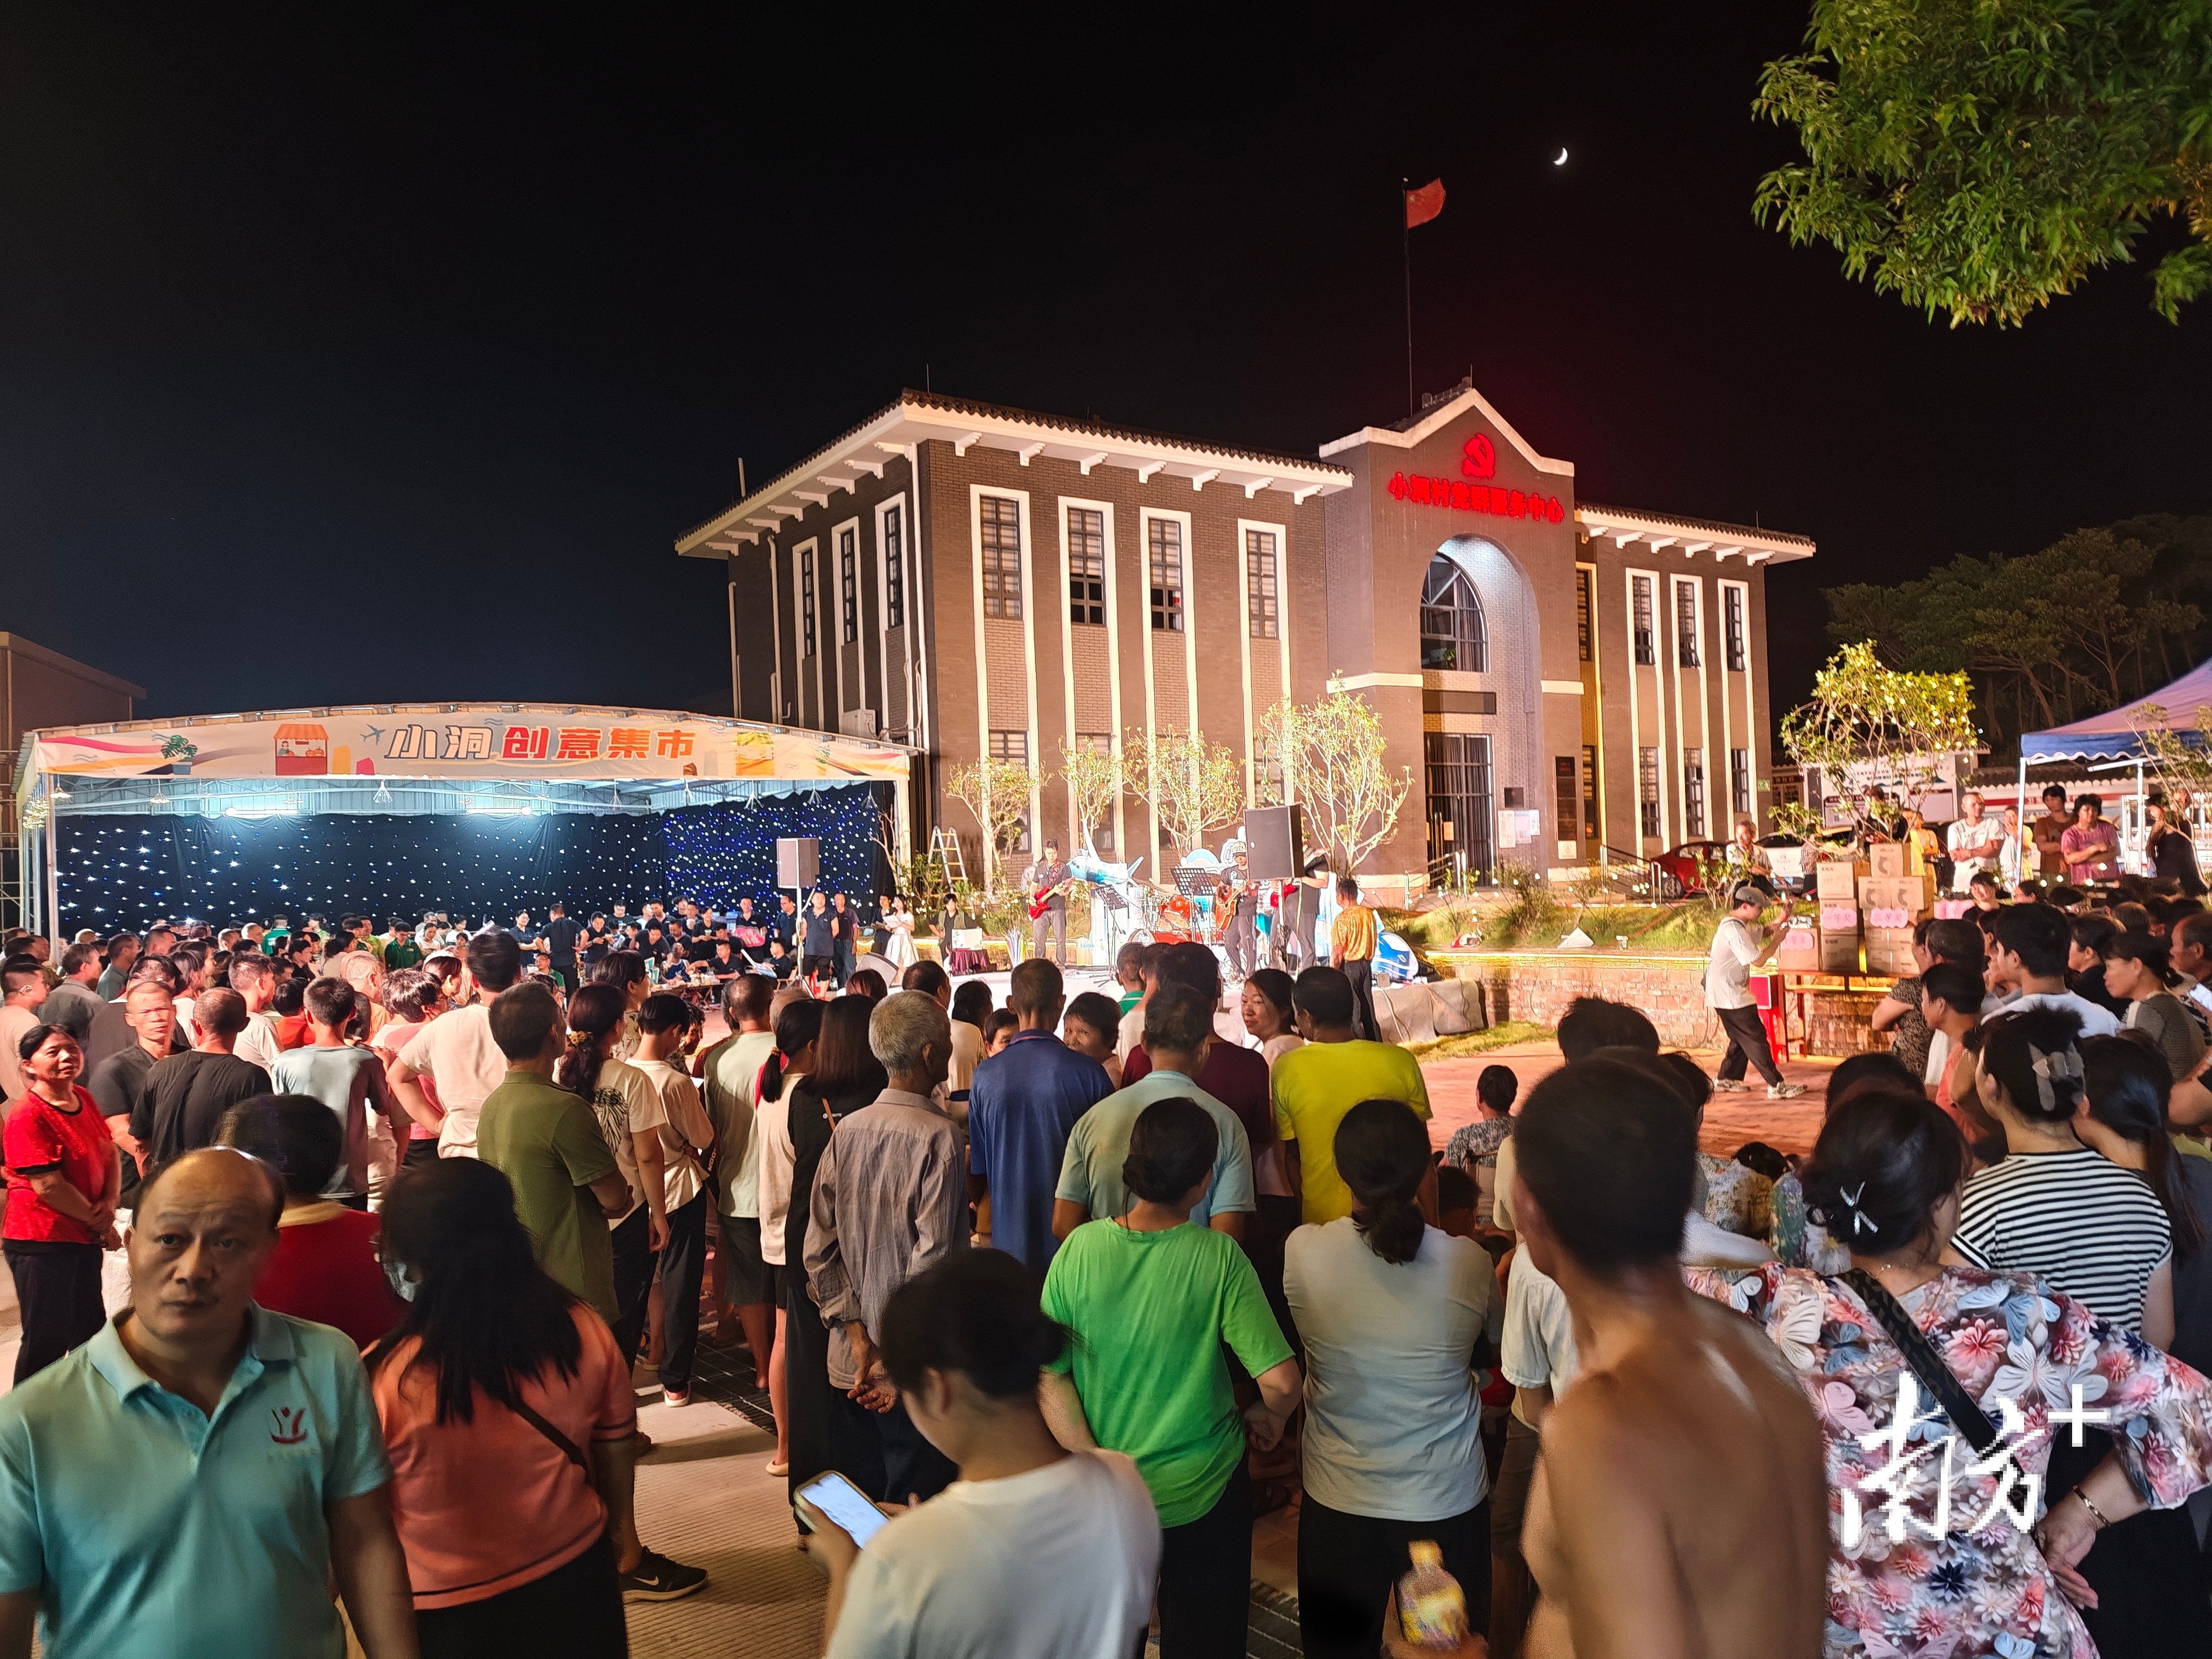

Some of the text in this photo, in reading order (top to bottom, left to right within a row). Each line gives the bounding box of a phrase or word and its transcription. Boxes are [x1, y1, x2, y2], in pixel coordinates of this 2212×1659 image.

[1388, 471, 1564, 522] 小洞村党群服务中心
[384, 724, 697, 760] 小洞创意集市
